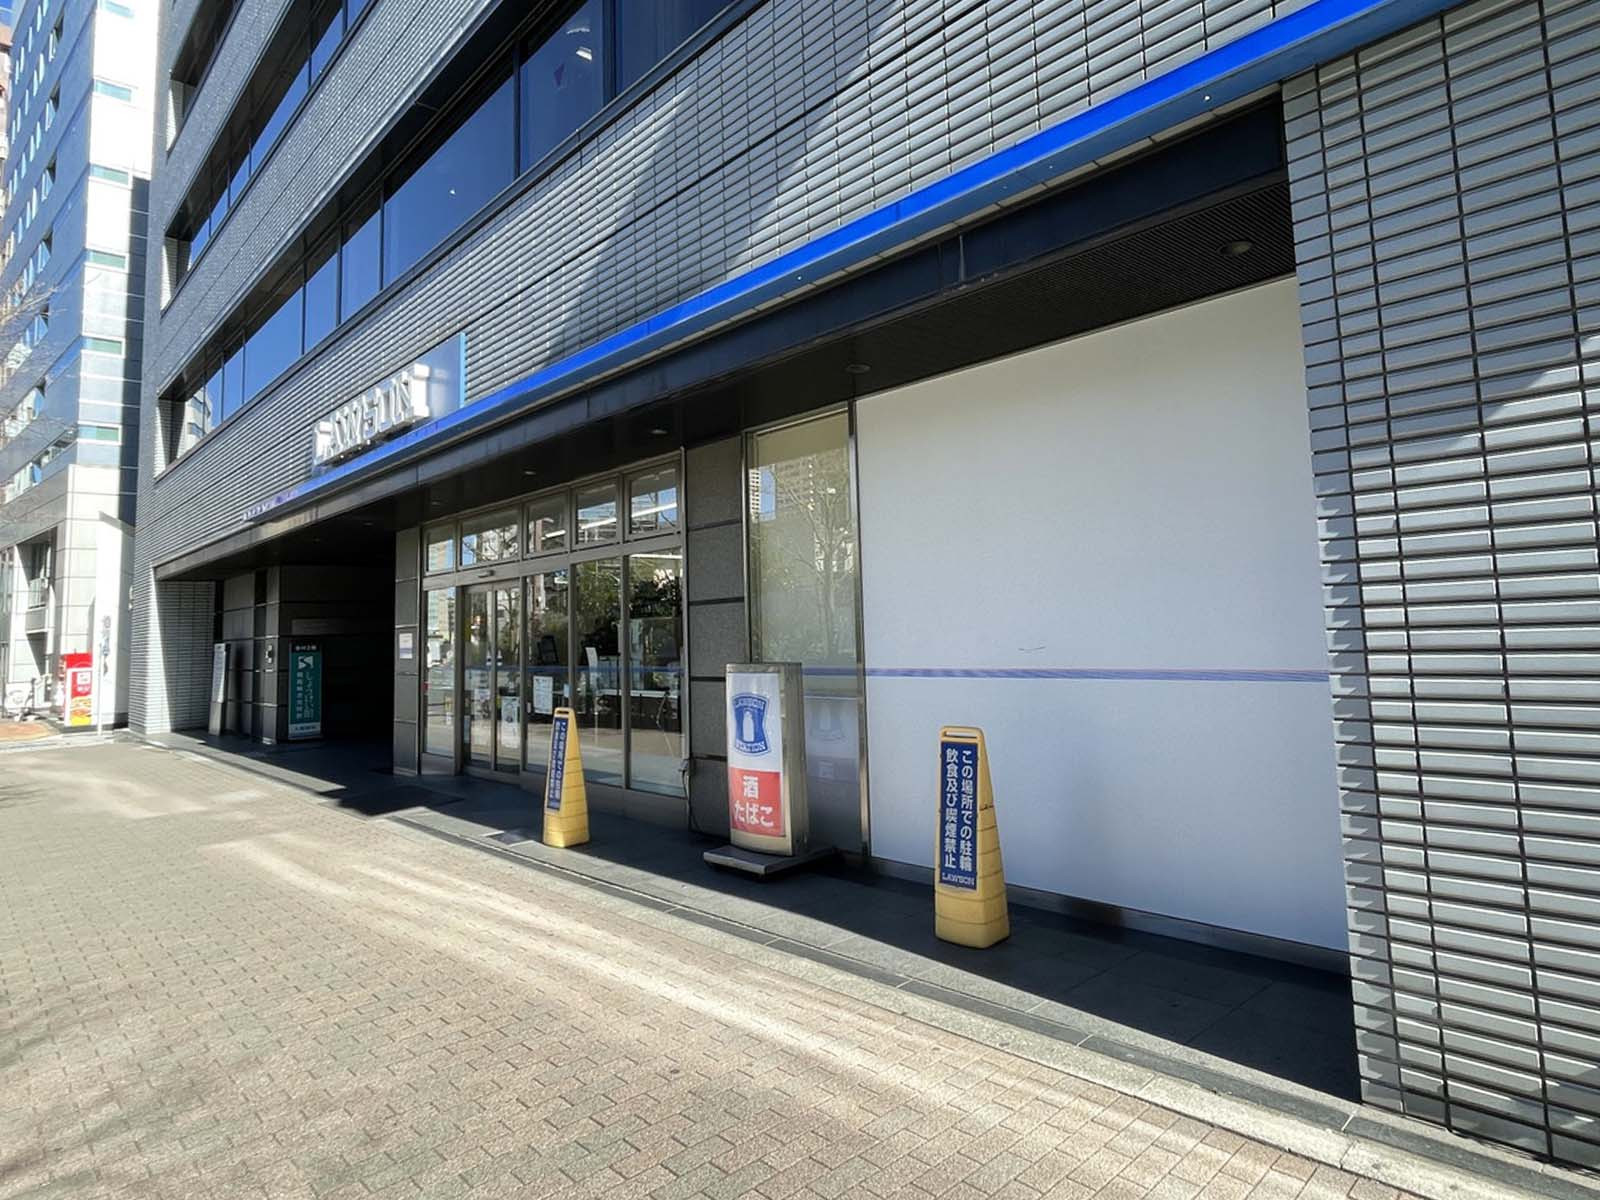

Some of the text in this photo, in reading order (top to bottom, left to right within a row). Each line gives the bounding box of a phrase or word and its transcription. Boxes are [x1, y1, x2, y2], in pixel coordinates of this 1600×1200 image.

[743, 775, 759, 799] 酒
[733, 799, 774, 827] たばこ
[944, 748, 959, 869] 飲食及び喫煙禁止
[959, 750, 974, 872] この場所での駐輪
[941, 872, 975, 886] LAWSON
